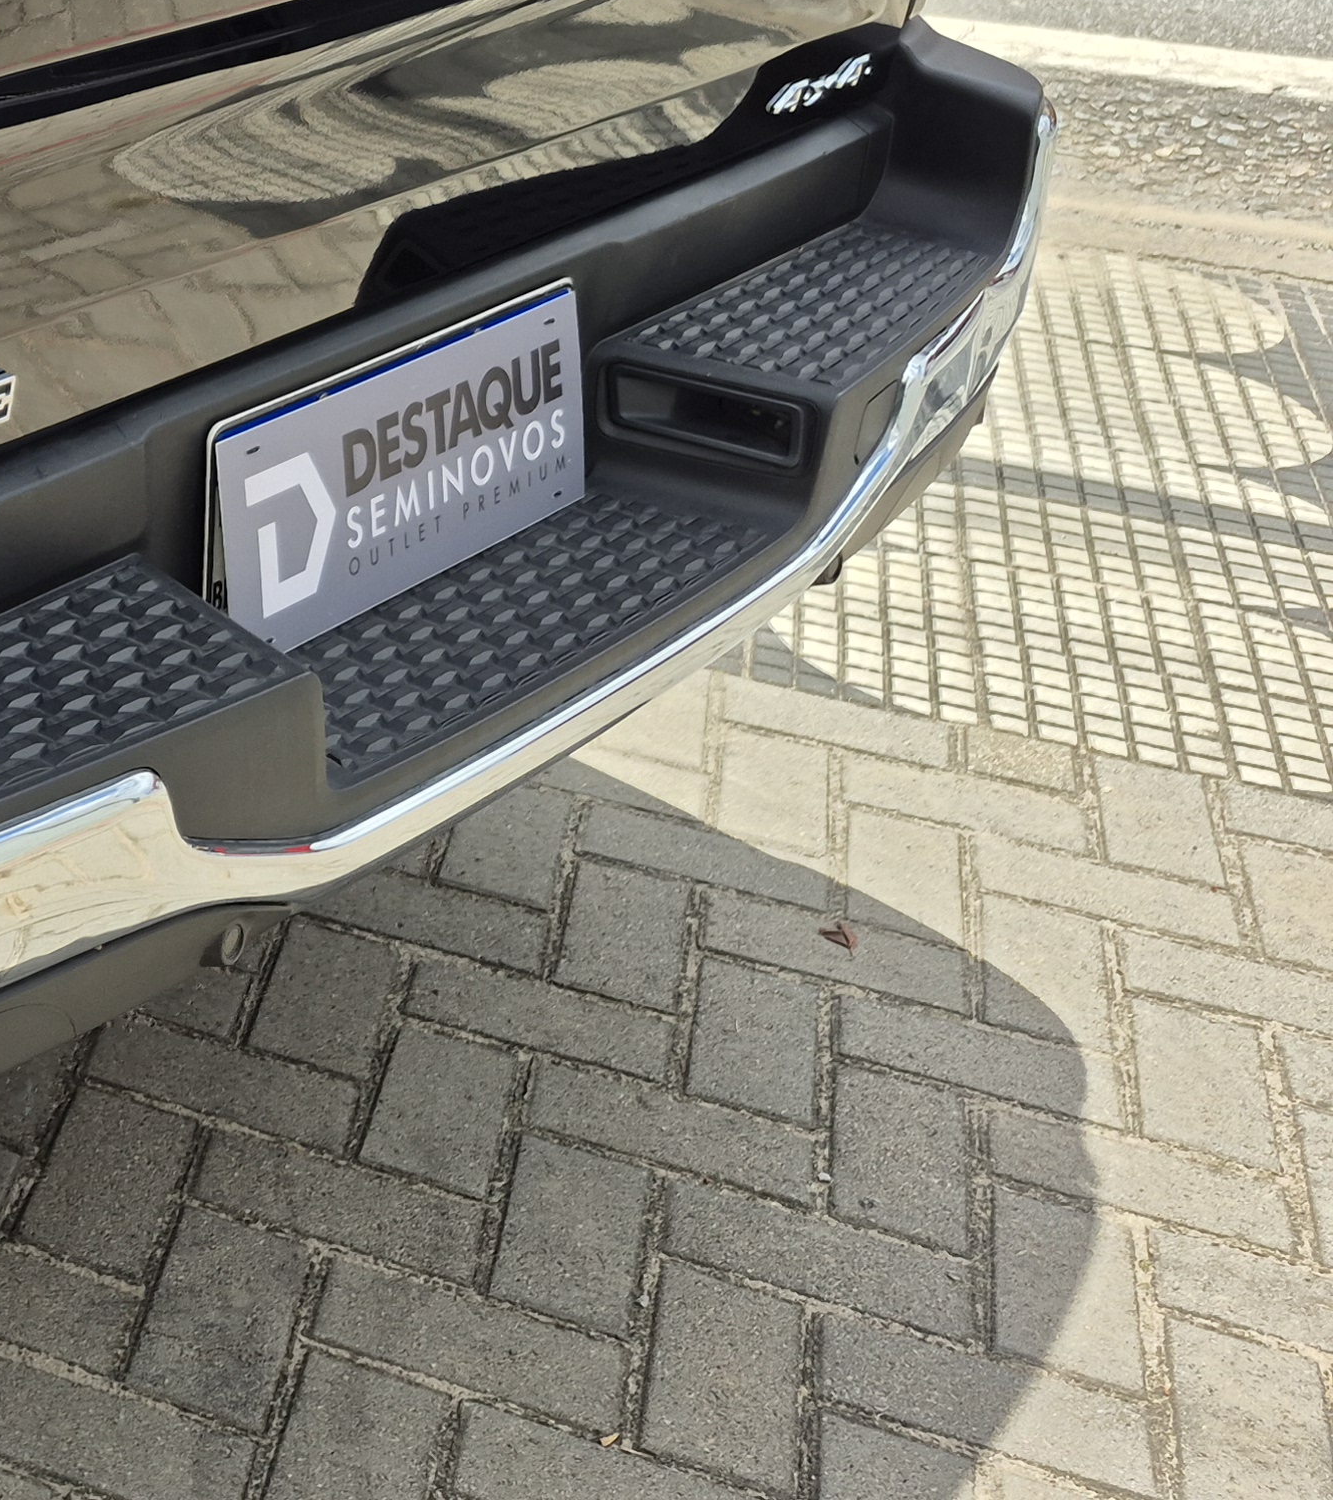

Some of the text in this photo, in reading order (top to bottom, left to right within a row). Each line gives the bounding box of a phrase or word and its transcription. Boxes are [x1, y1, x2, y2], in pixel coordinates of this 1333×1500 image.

[766, 53, 875, 116] 4x4
[341, 338, 565, 498] DESTAQUE
[346, 407, 566, 550] SEMINOVOS
[347, 453, 568, 577] OUTLET PREMIUM
